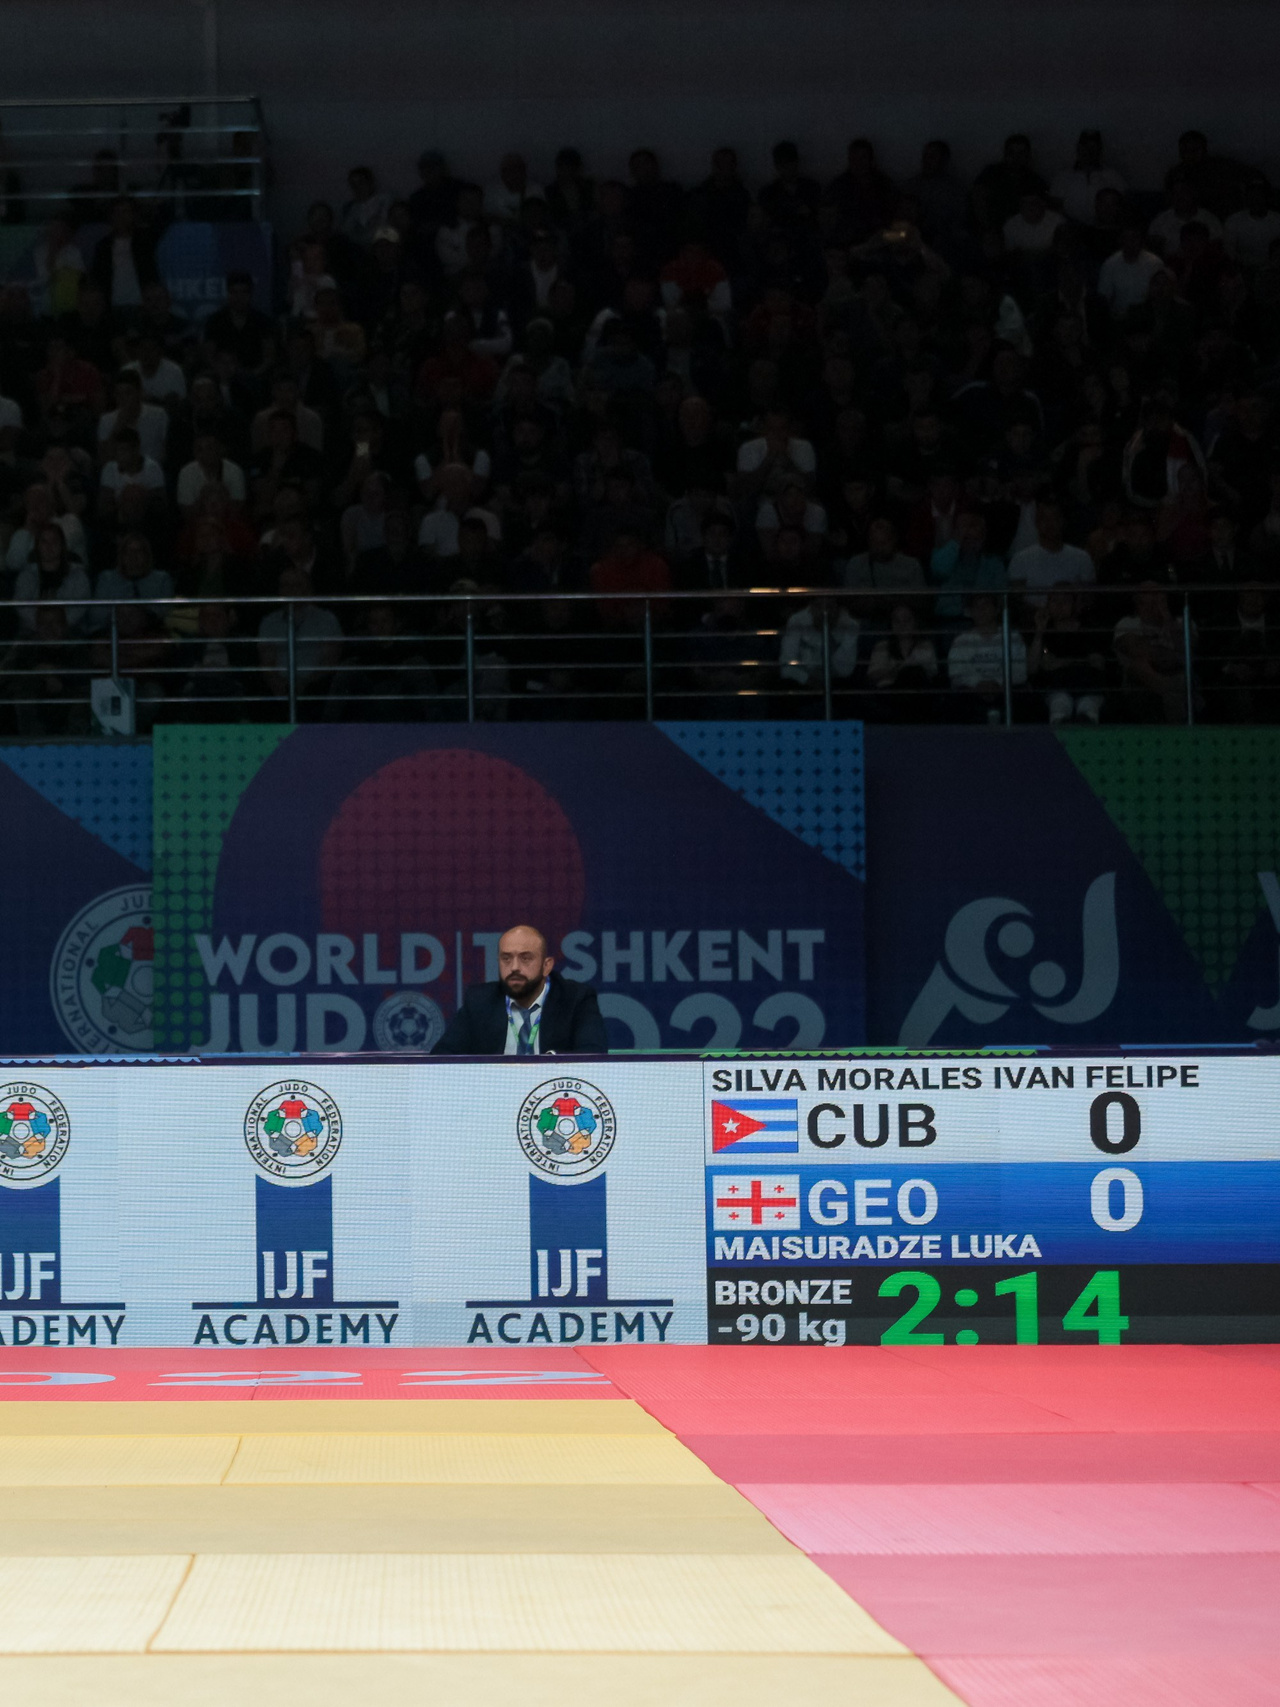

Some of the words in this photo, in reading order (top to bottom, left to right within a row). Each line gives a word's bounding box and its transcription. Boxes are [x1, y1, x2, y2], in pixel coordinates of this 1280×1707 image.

[195, 932, 446, 987] WORLD
[473, 929, 826, 984] TSHKENT
[597, 991, 826, 1052] 022
[712, 1068, 807, 1092] SILVA
[818, 1066, 982, 1091] MORALES
[994, 1066, 1075, 1090] IVAN
[1085, 1064, 1200, 1089] FELIPE
[7, 1085, 37, 1095] JUDO
[43, 1100, 67, 1168] FEDERATION
[247, 1097, 286, 1174] INTERNATIONAL
[279, 1083, 309, 1093] JUDO
[316, 1098, 339, 1166] FEDERATION
[521, 1094, 560, 1172] INTERNATIONAL
[551, 1081, 582, 1090] JUDO
[589, 1095, 613, 1165] FEDERATION
[806, 1103, 938, 1149] CUB
[1089, 1091, 1142, 1155] 0
[807, 1178, 940, 1227] GEO
[1089, 1166, 1145, 1233] 0
[261, 1250, 328, 1299] IJF
[536, 1248, 603, 1298] IJF
[714, 1235, 941, 1261] MAISURADZE
[951, 1234, 1043, 1259] LUKA
[715, 1279, 852, 1306] BRONZE
[877, 1269, 1130, 1346] 2:14
[193, 1313, 399, 1345] ACADEMY
[467, 1311, 674, 1344] ACADEMY
[717, 1313, 785, 1342] -90
[799, 1312, 847, 1347] kg
